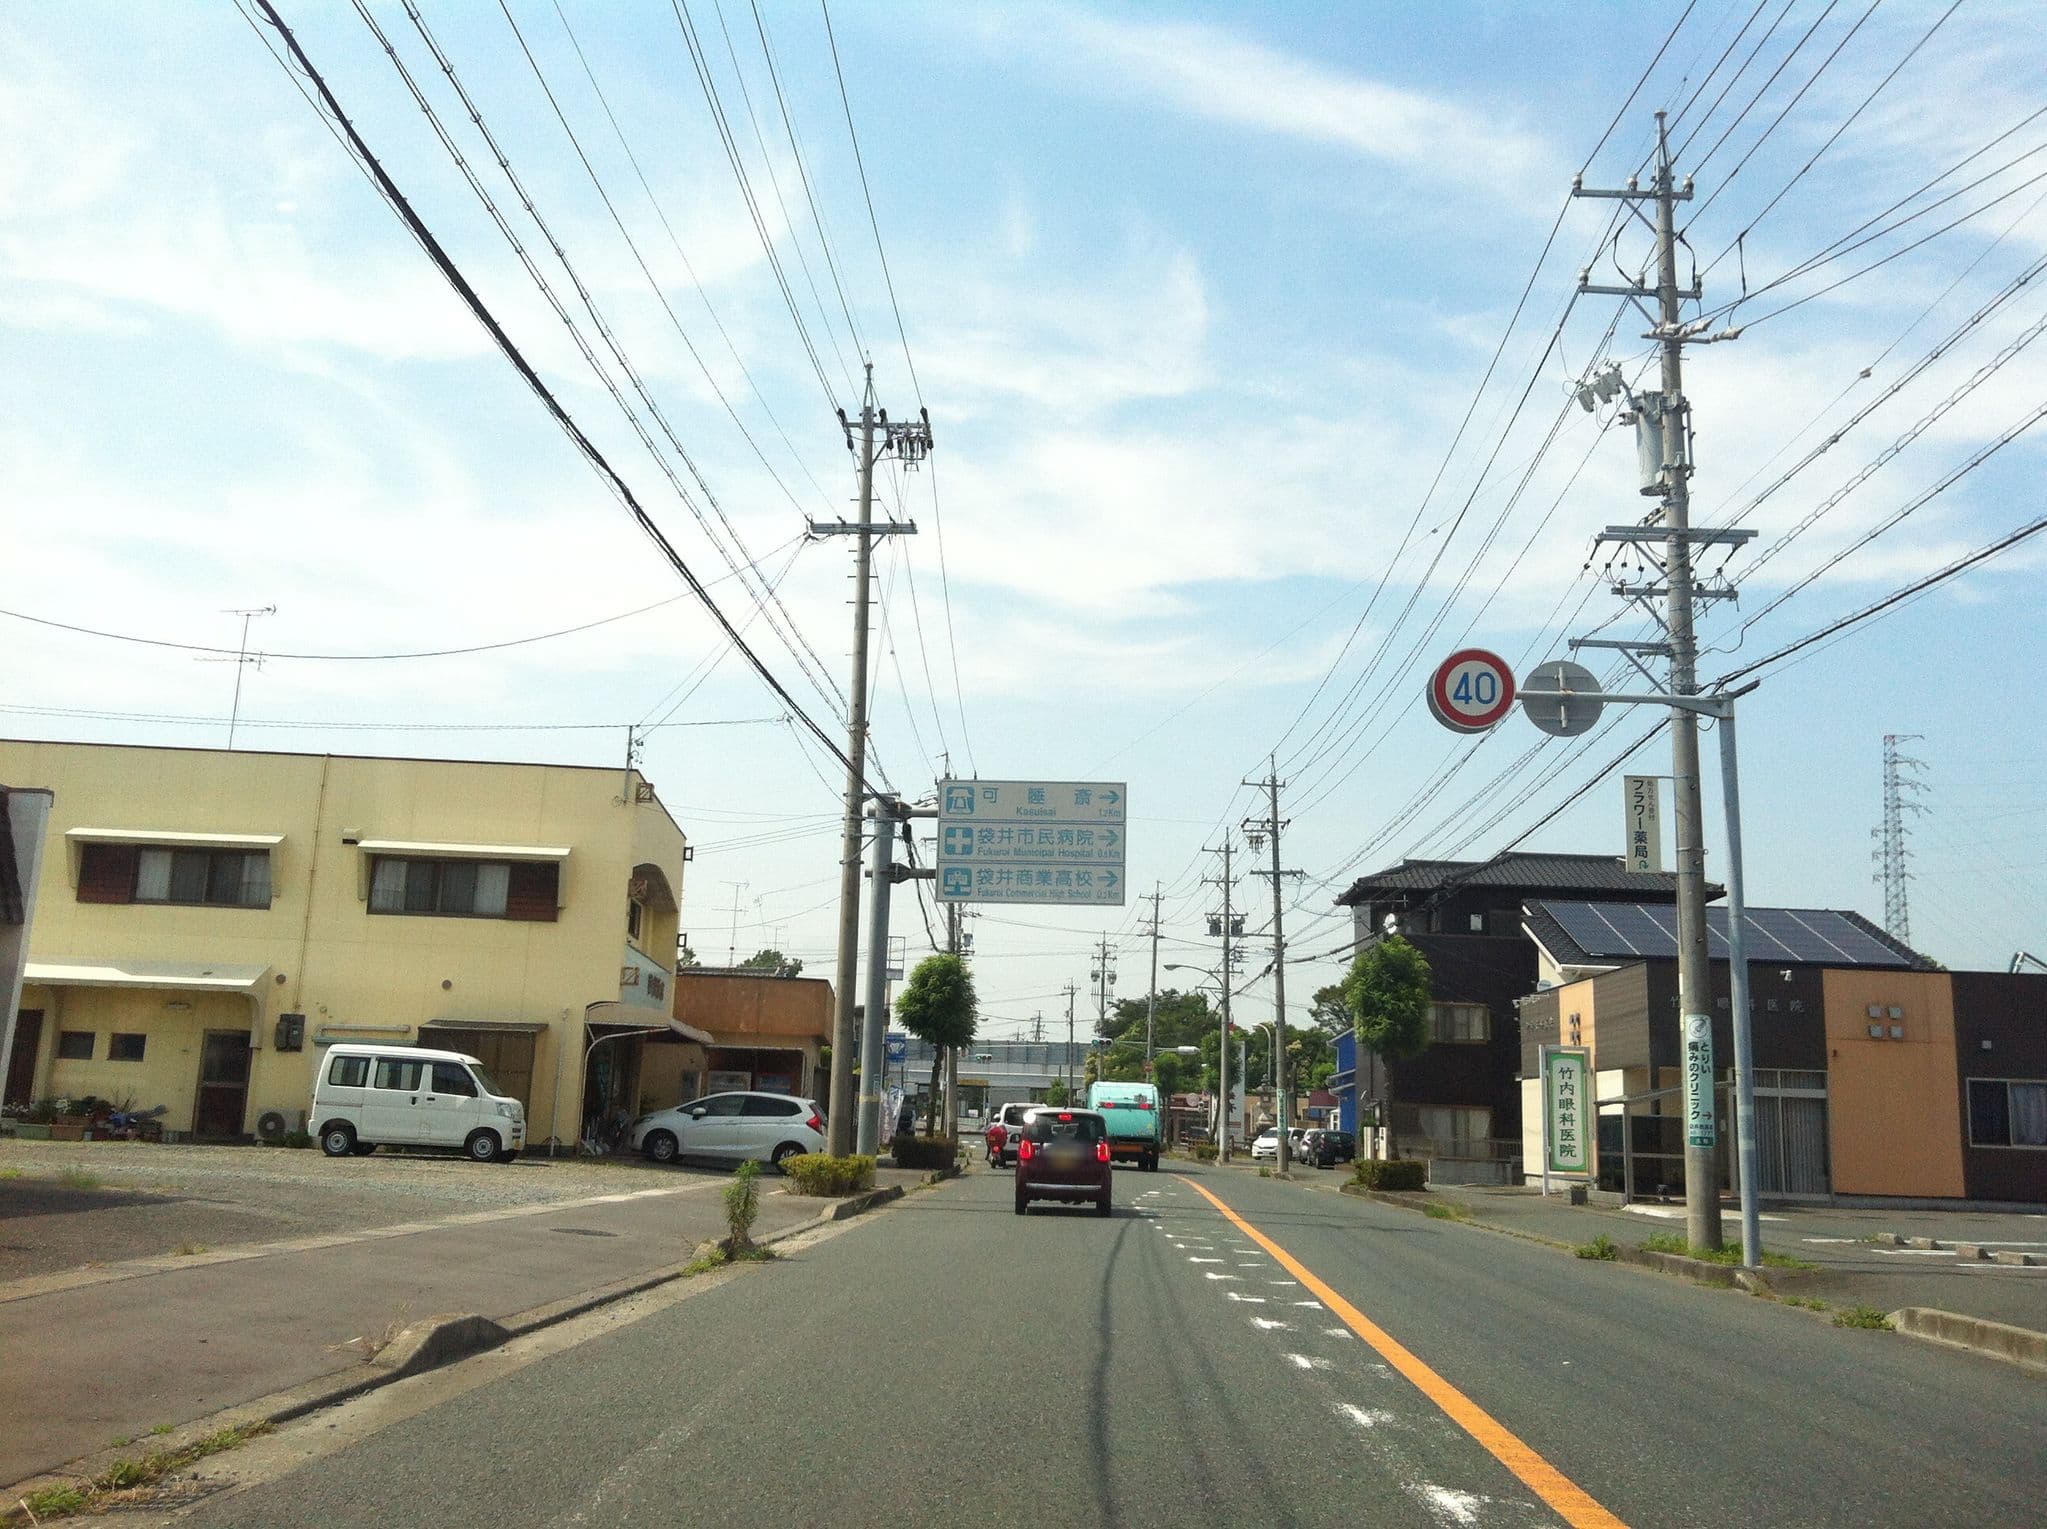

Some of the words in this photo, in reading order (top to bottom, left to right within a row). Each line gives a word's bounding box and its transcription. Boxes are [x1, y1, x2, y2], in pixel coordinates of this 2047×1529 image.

[1453, 671, 1496, 705] 40
[978, 827, 1094, 845] 袋井市民病院
[1633, 780, 1648, 859] フラワー薬局
[1058, 849, 1093, 858] Hospital
[976, 868, 1093, 887] 袋井商業高校
[1700, 1042, 1711, 1074] とりい
[1688, 1041, 1700, 1120] 痛みのクリニック
[1558, 1067, 1577, 1157] 竹内眼科医院
